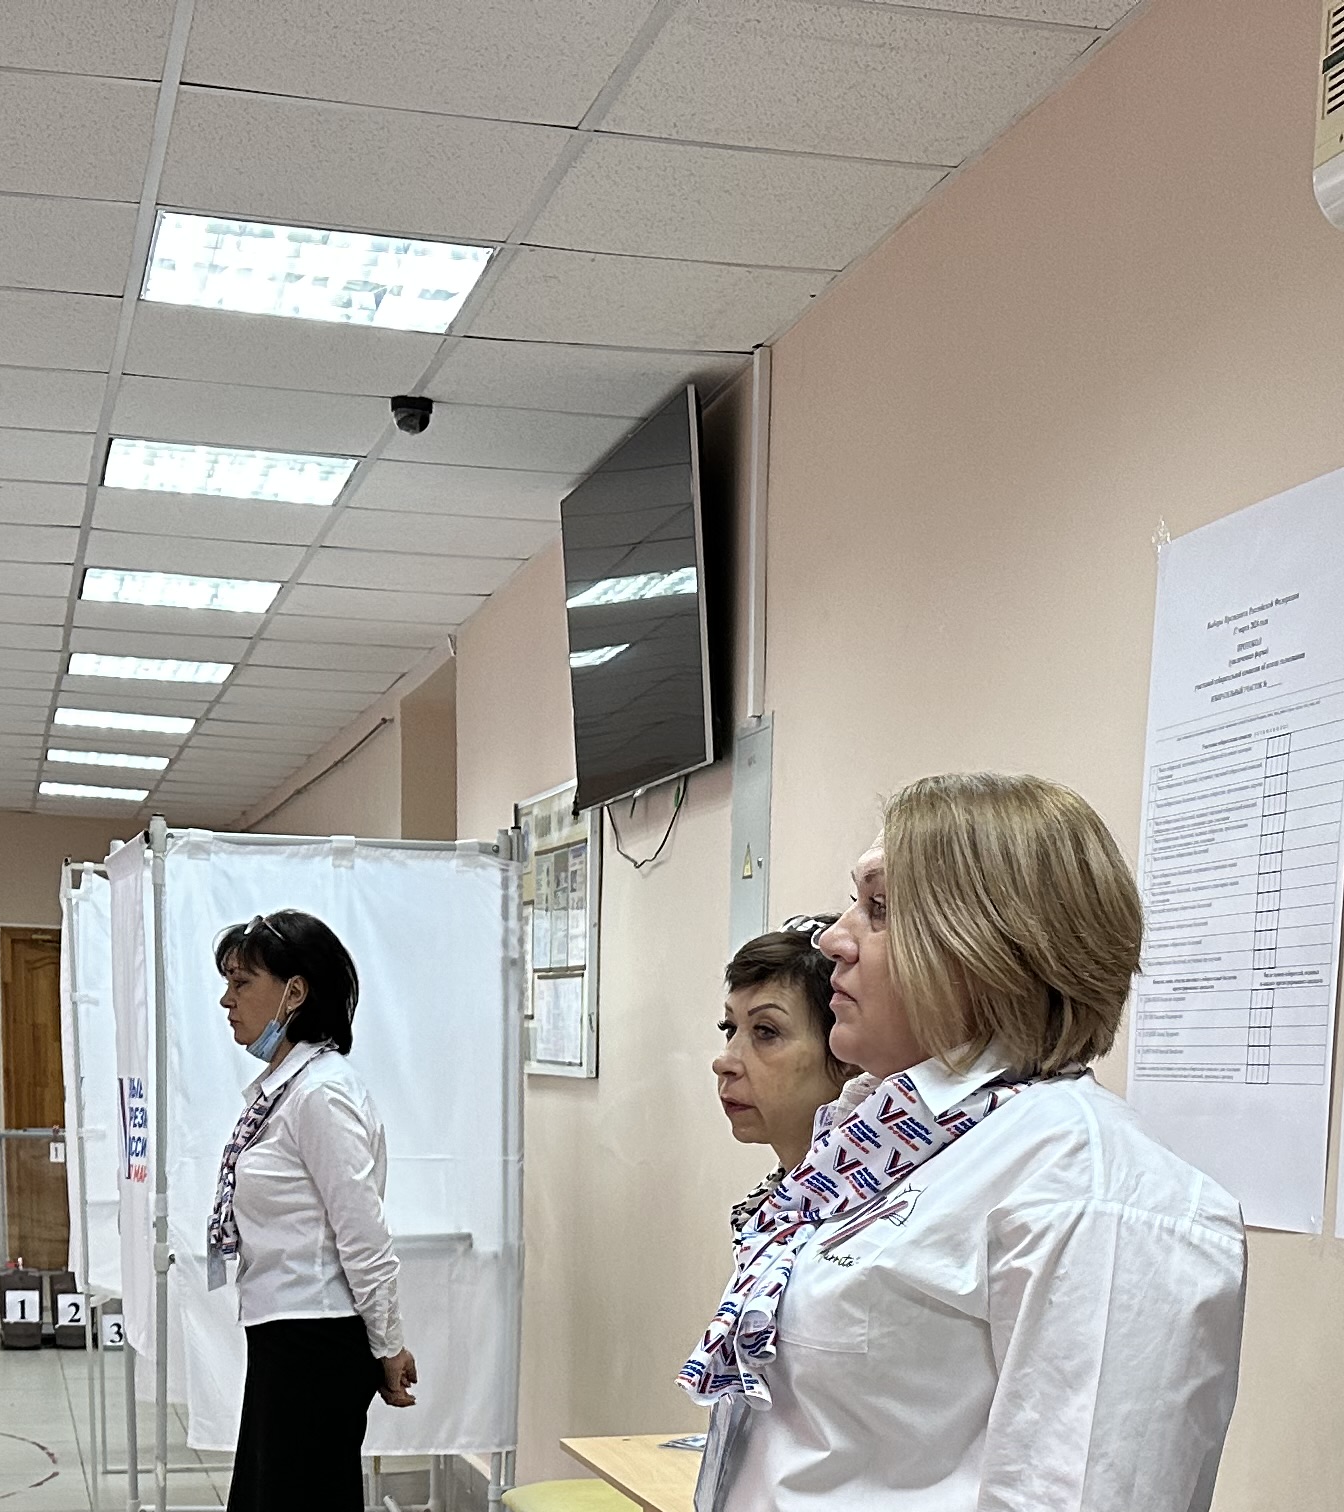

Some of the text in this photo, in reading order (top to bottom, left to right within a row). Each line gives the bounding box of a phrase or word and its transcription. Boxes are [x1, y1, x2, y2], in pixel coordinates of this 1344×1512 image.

[18, 1299, 27, 1320] 1
[68, 1303, 81, 1323] 2
[109, 1322, 123, 1343] 3
